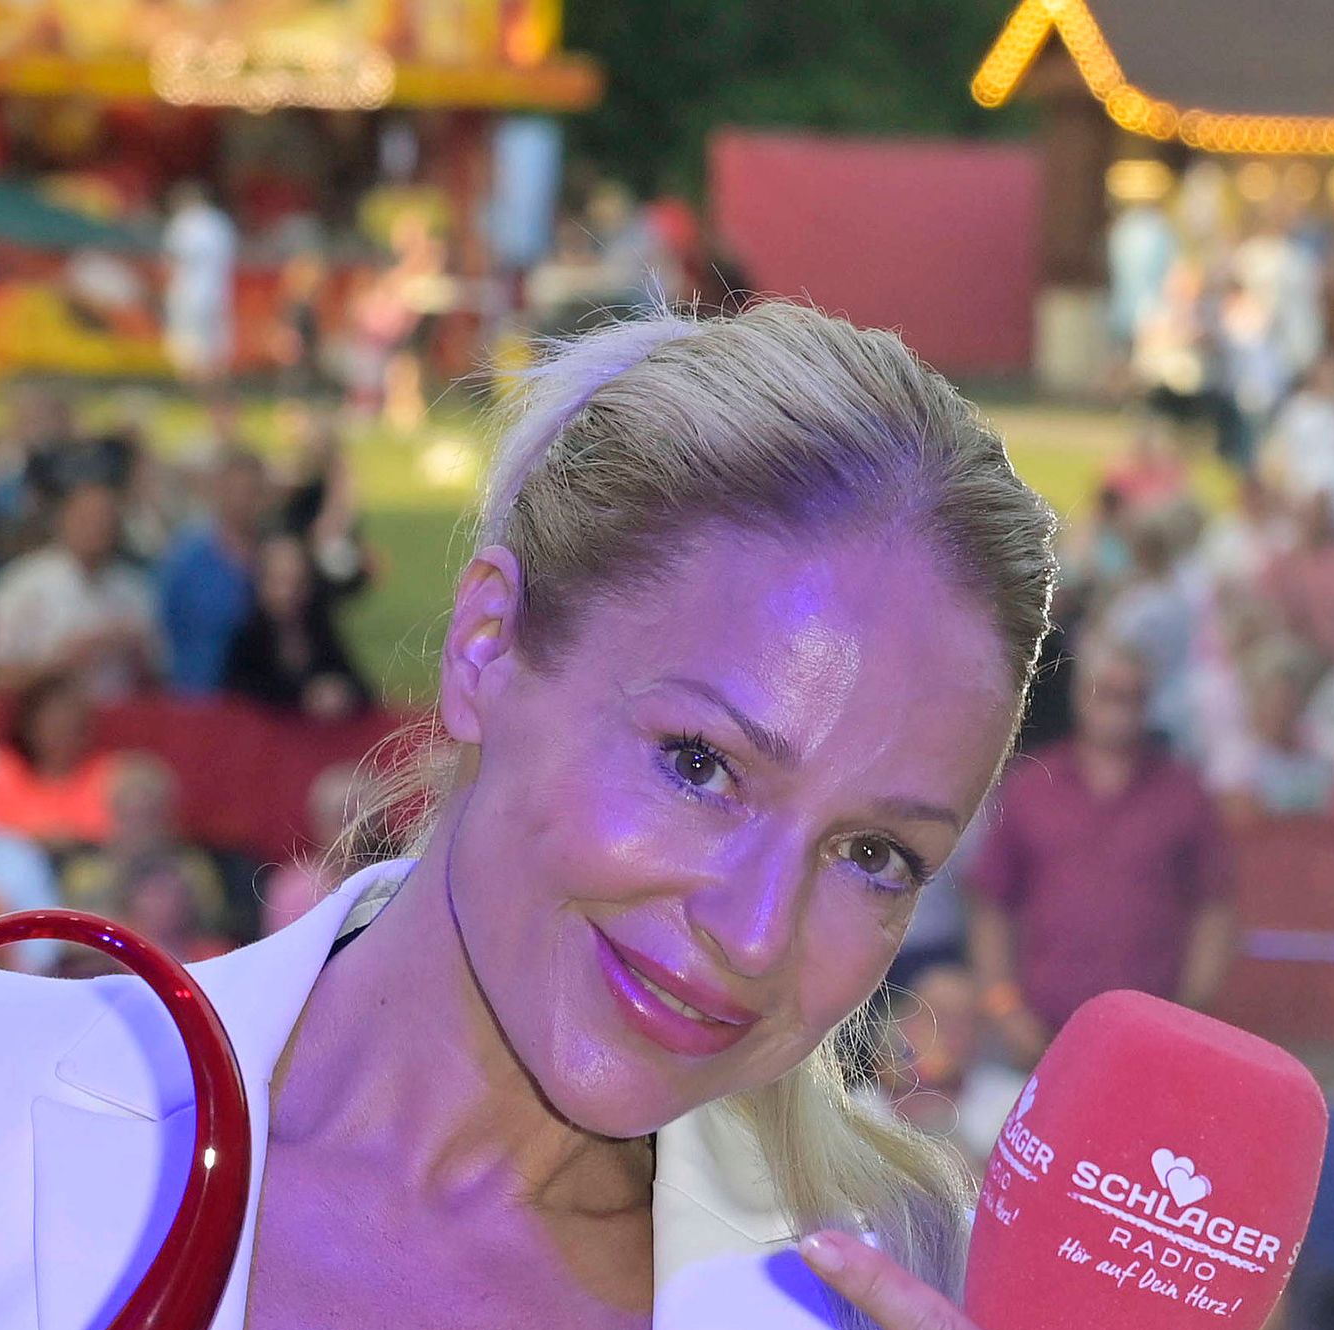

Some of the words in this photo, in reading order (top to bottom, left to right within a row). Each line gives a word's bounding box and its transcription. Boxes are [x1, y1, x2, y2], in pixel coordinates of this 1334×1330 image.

[1071, 1160, 1281, 1263] SCHLAGER
[1057, 1236, 1092, 1264] Hör
[1095, 1260, 1141, 1288] auf
[1137, 1267, 1179, 1300] Dein
[1184, 1284, 1243, 1319] Herz!
[1108, 1226, 1216, 1281] RADIO
